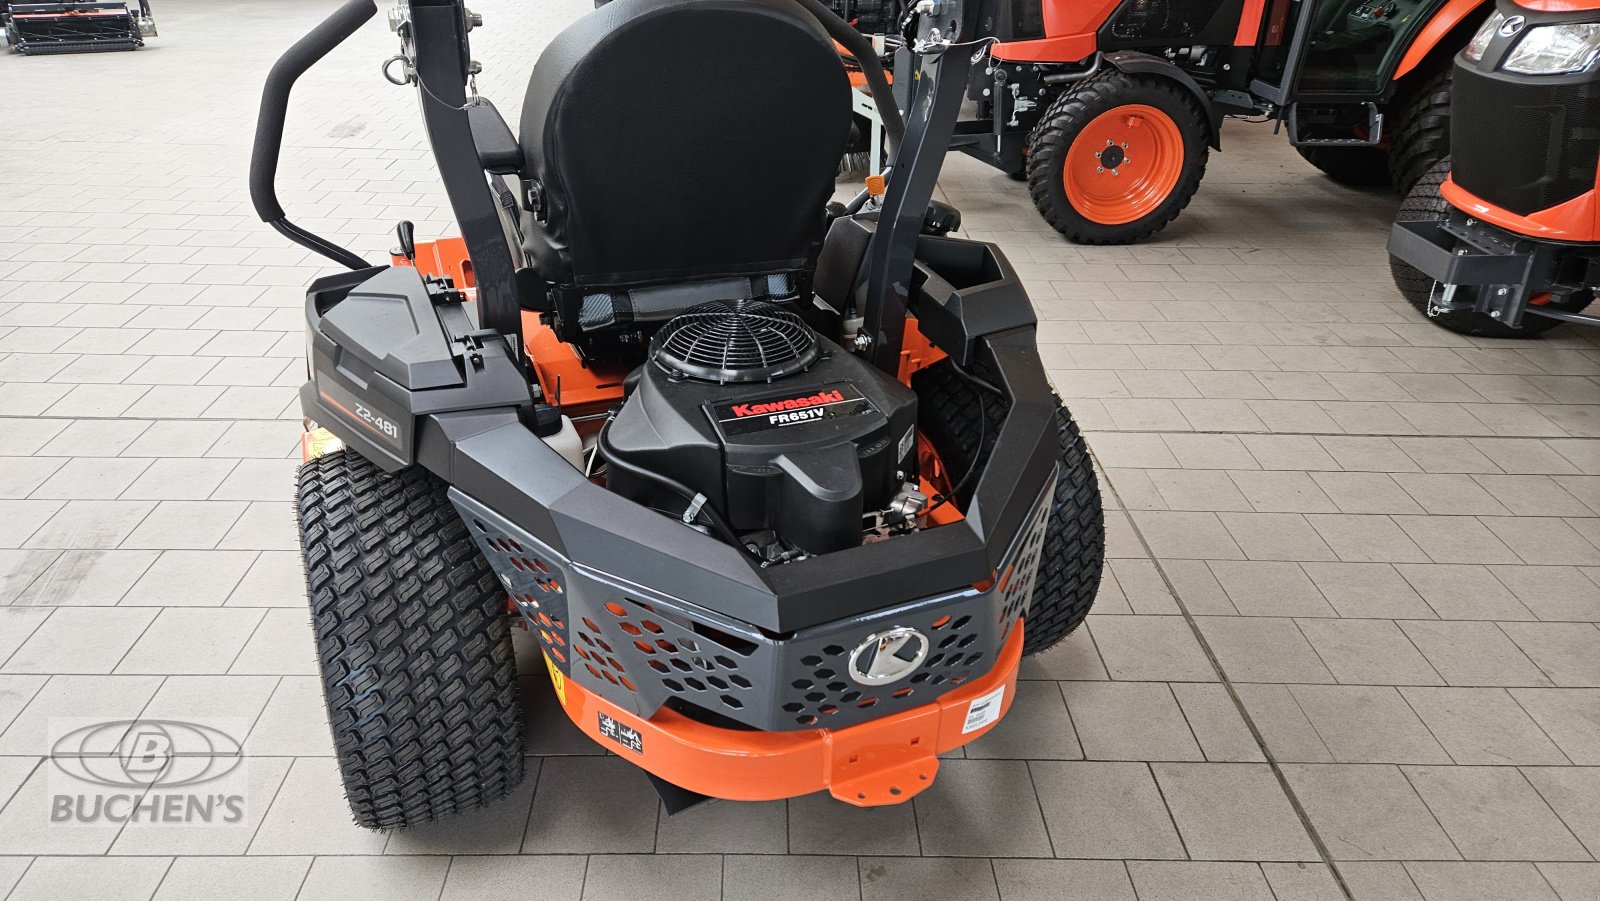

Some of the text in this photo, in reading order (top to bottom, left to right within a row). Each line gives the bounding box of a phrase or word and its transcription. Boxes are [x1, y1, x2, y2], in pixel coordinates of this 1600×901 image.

[731, 389, 845, 418] Kawasaki
[769, 407, 825, 425] FR651V
[355, 402, 398, 439] Z2-481
